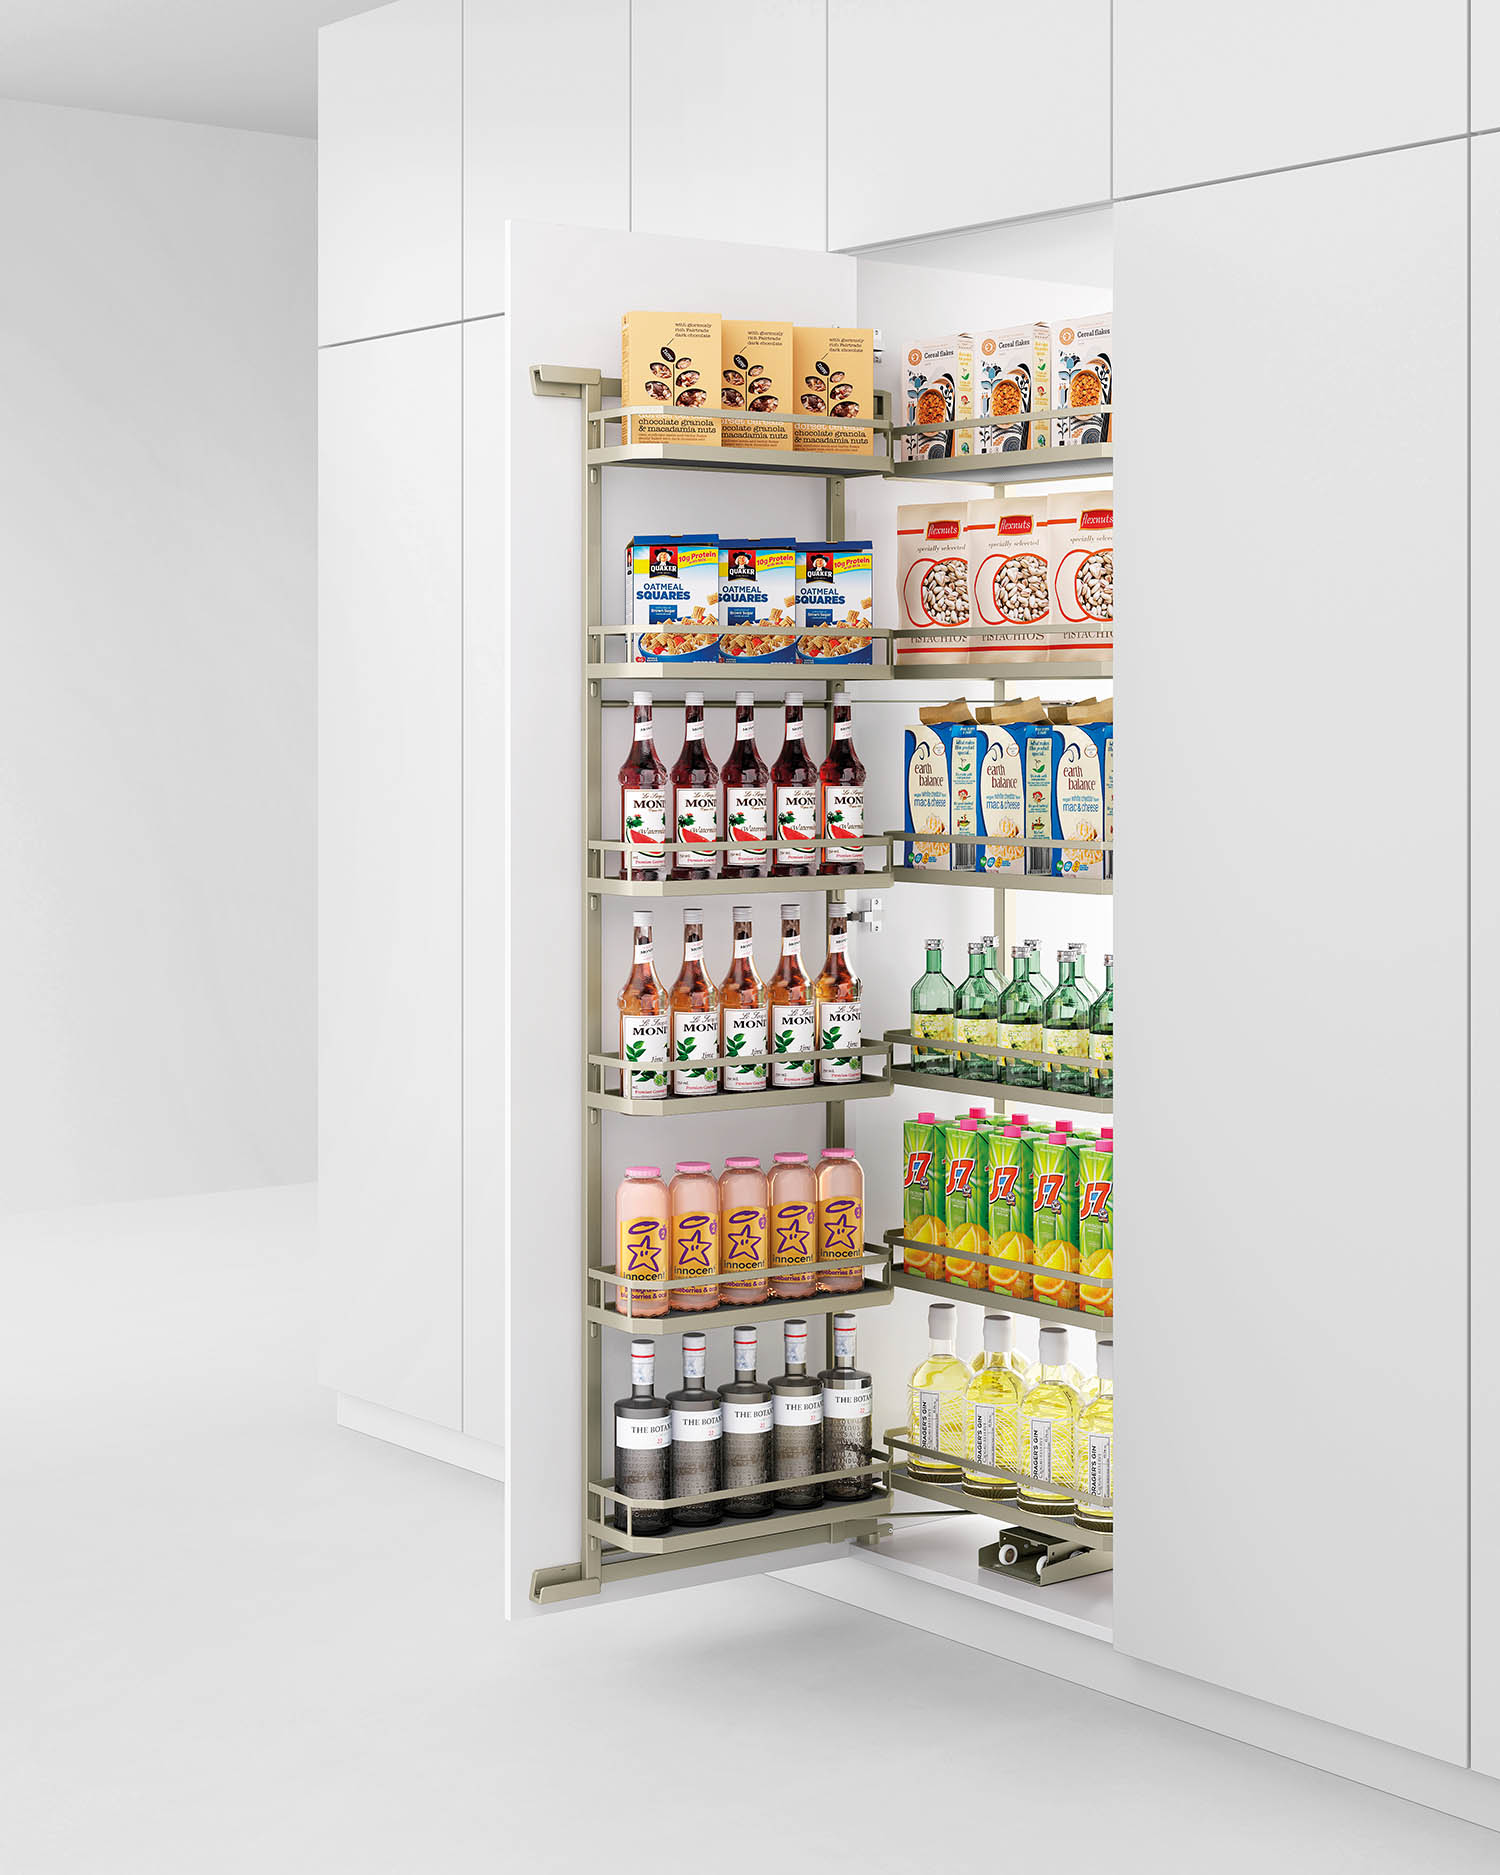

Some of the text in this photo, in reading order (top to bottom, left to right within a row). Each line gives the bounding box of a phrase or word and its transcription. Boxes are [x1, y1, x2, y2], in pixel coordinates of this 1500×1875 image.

[1077, 330, 1094, 338] Cereal
[998, 341, 1014, 349] Cereal
[924, 351, 939, 359] Cereal
[681, 419, 714, 427] granola
[753, 426, 786, 434] granola
[834, 431, 866, 439] granola
[928, 524, 957, 537] flexnuts
[1000, 519, 1031, 532] flexnuts
[679, 555, 690, 563] 10g
[691, 551, 717, 560] Protein
[768, 554, 793, 563] Protein
[846, 557, 870, 565] Protein
[807, 570, 832, 578] QUAKER
[636, 591, 691, 600] SQUARES
[718, 593, 768, 603] SQUARES
[795, 595, 845, 605] SQUARES
[914, 763, 933, 774] earth
[986, 764, 1006, 776] earth
[1063, 766, 1083, 777] earth
[919, 775, 944, 787] balance
[991, 776, 1018, 789] balance
[1068, 778, 1096, 791] balance
[820, 1248, 860, 1258] innocent
[772, 1254, 813, 1264] innocent
[674, 1265, 716, 1275] innocent
[724, 1260, 765, 1270] innocent
[623, 1271, 665, 1281] innocent
[785, 1403, 802, 1411] THE
[682, 1418, 699, 1426] THE
[631, 1426, 648, 1434] THE
